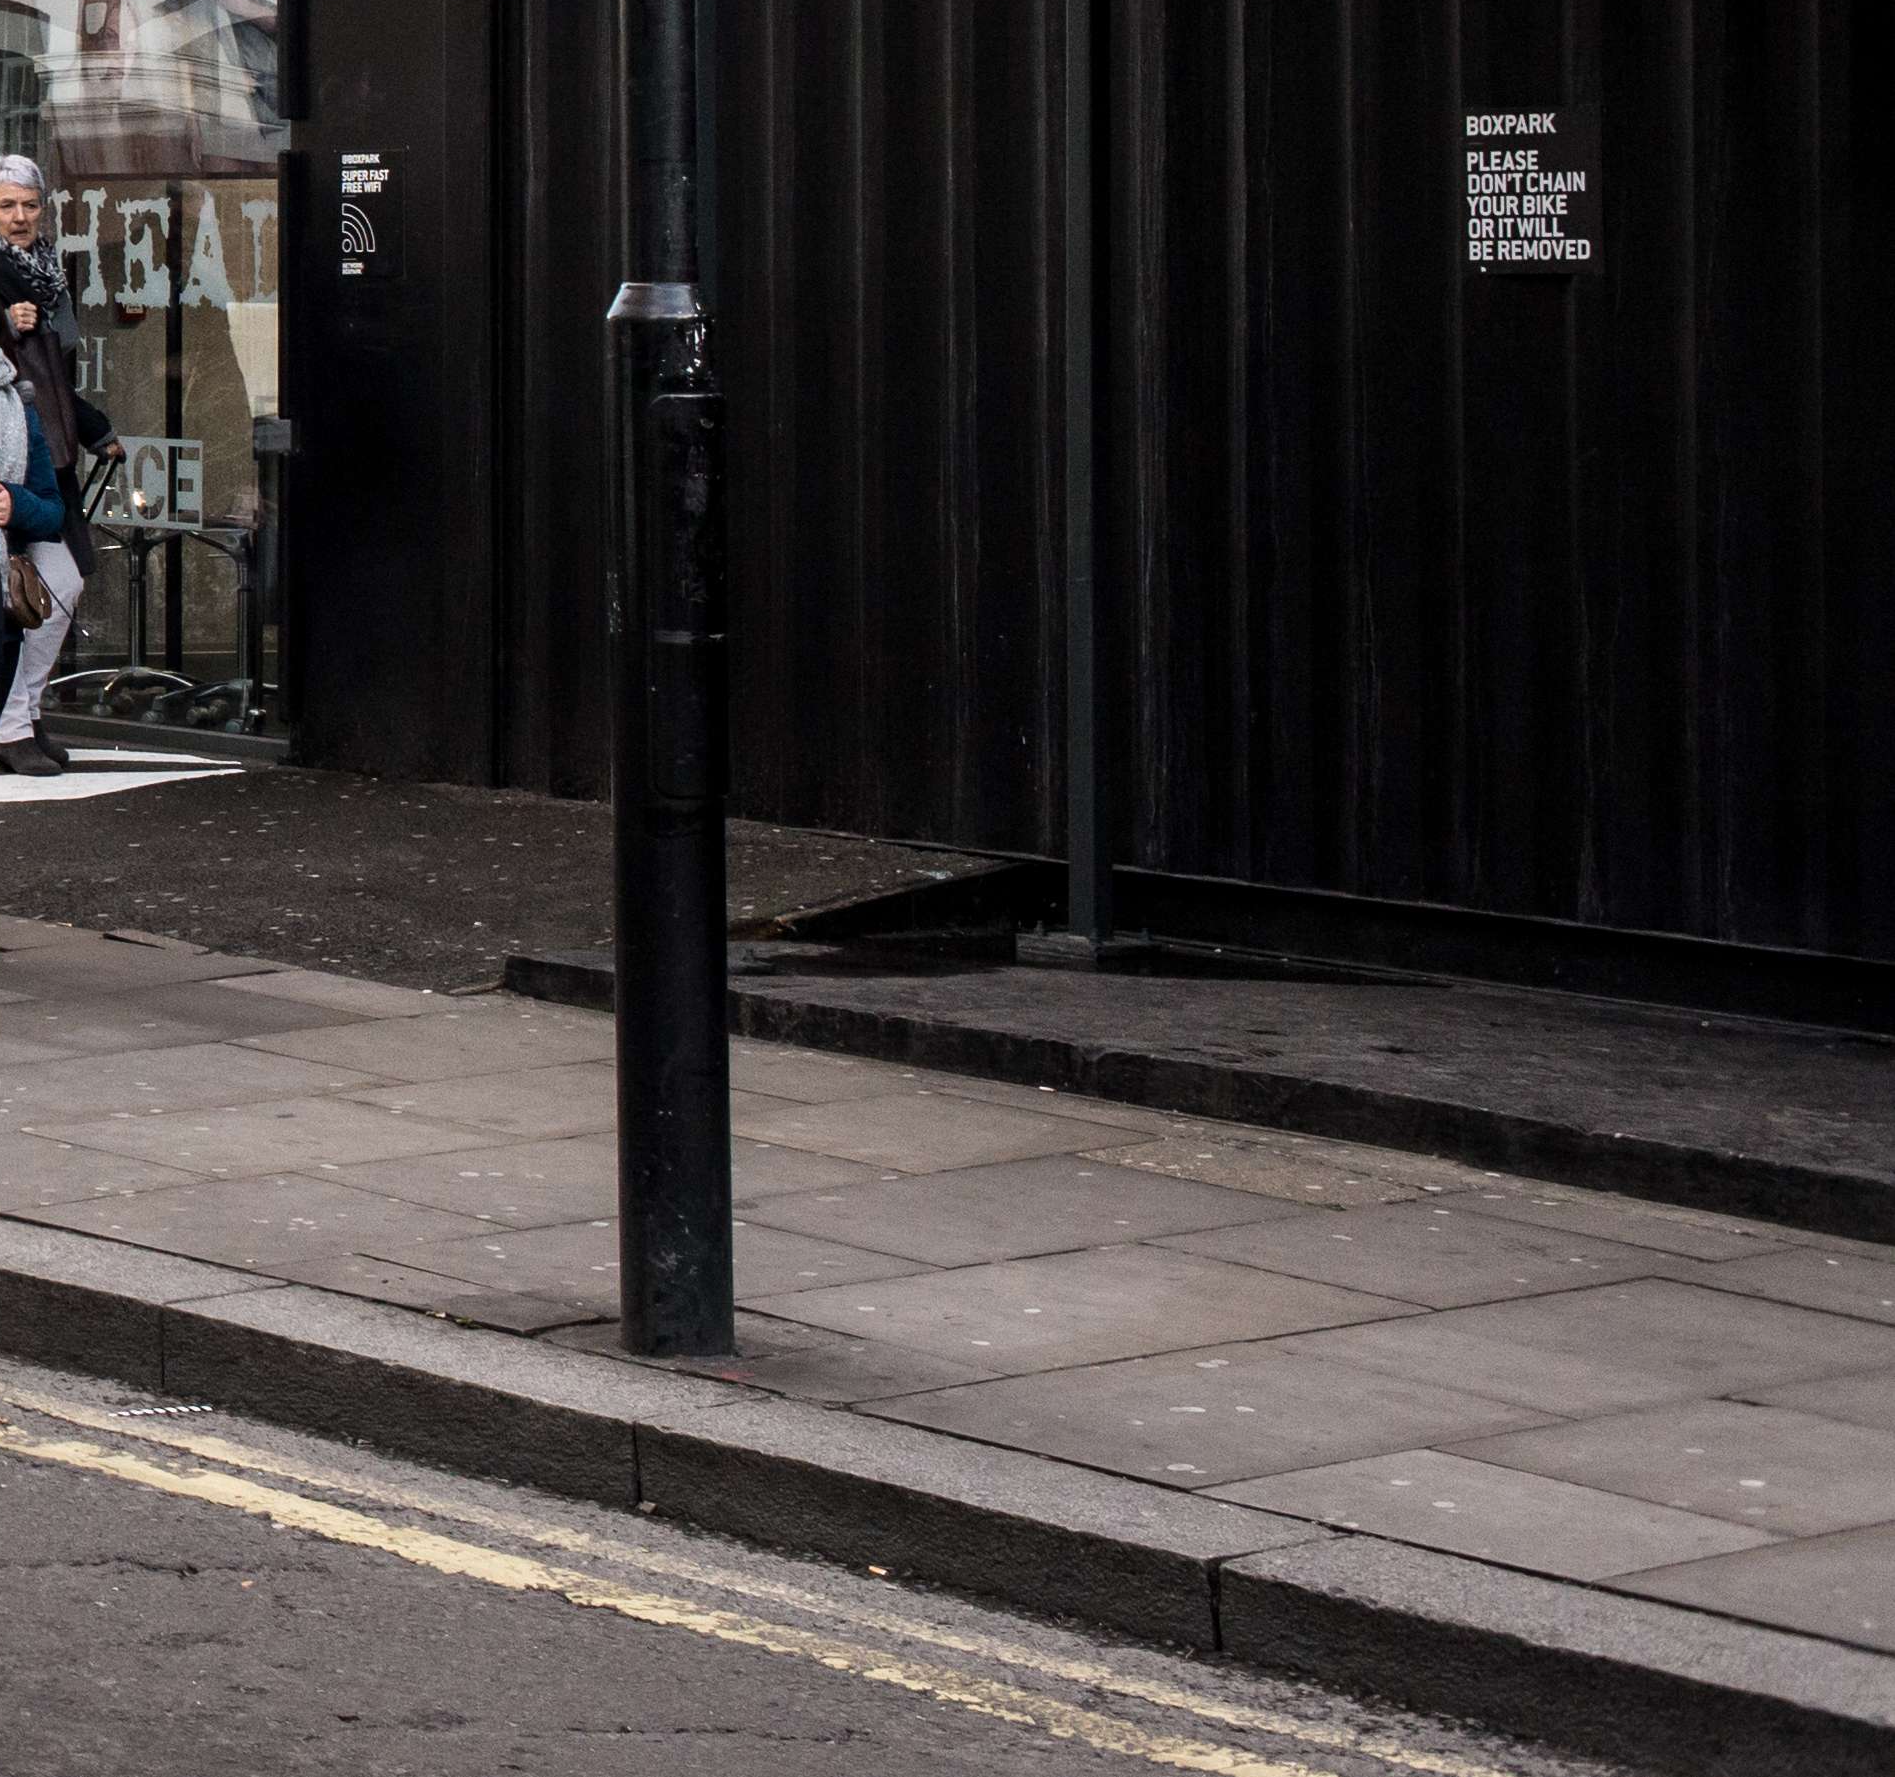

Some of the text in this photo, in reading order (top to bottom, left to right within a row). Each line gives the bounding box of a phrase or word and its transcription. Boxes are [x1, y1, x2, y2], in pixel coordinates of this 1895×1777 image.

[1466, 113, 1556, 136] BOXPARK
[1466, 150, 1539, 171] PLEASE
[341, 169, 389, 181] SUPER FAST
[1467, 171, 1586, 194] DON'T CHAIN
[341, 181, 382, 193] FREE WIFI
[1467, 194, 1568, 216] YOUR BIKE
[1468, 217, 1564, 238] OR IT WILL
[1469, 239, 1591, 260] BE REMOVED
